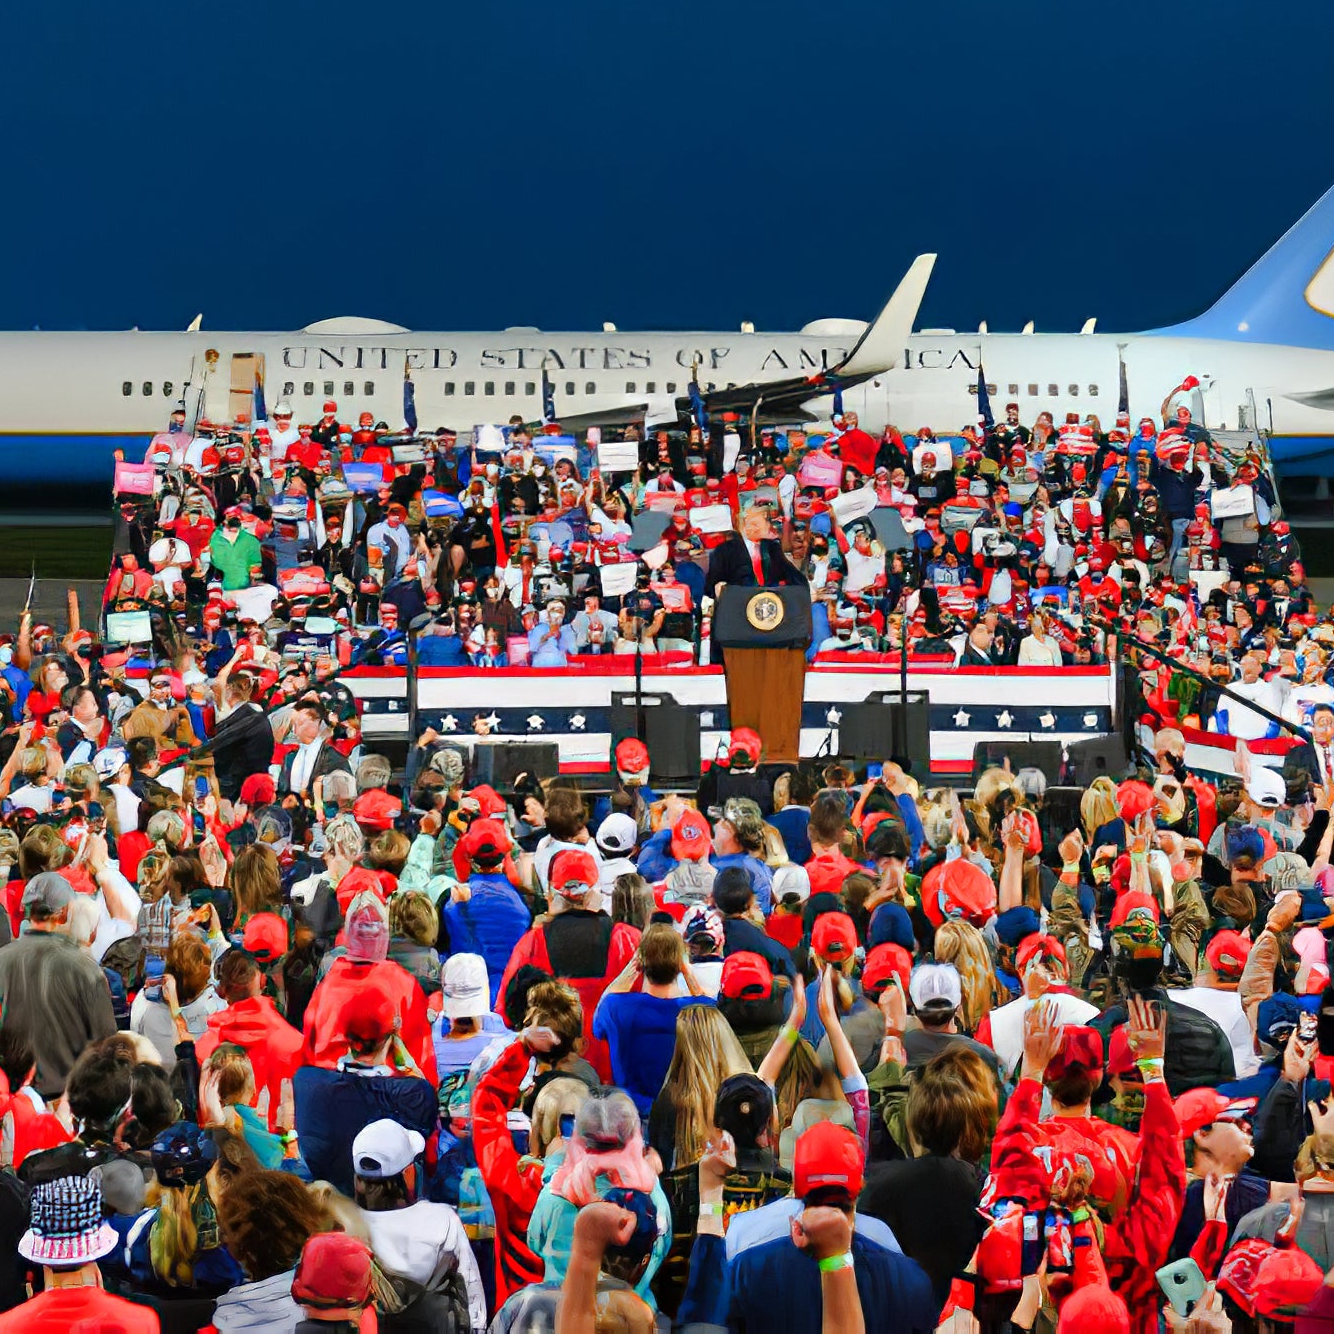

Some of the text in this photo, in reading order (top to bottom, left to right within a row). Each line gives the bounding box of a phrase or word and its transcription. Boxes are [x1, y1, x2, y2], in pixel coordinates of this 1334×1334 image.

[282, 346, 458, 369] UNITED
[480, 346, 651, 370] STATES
[675, 346, 731, 370] OF
